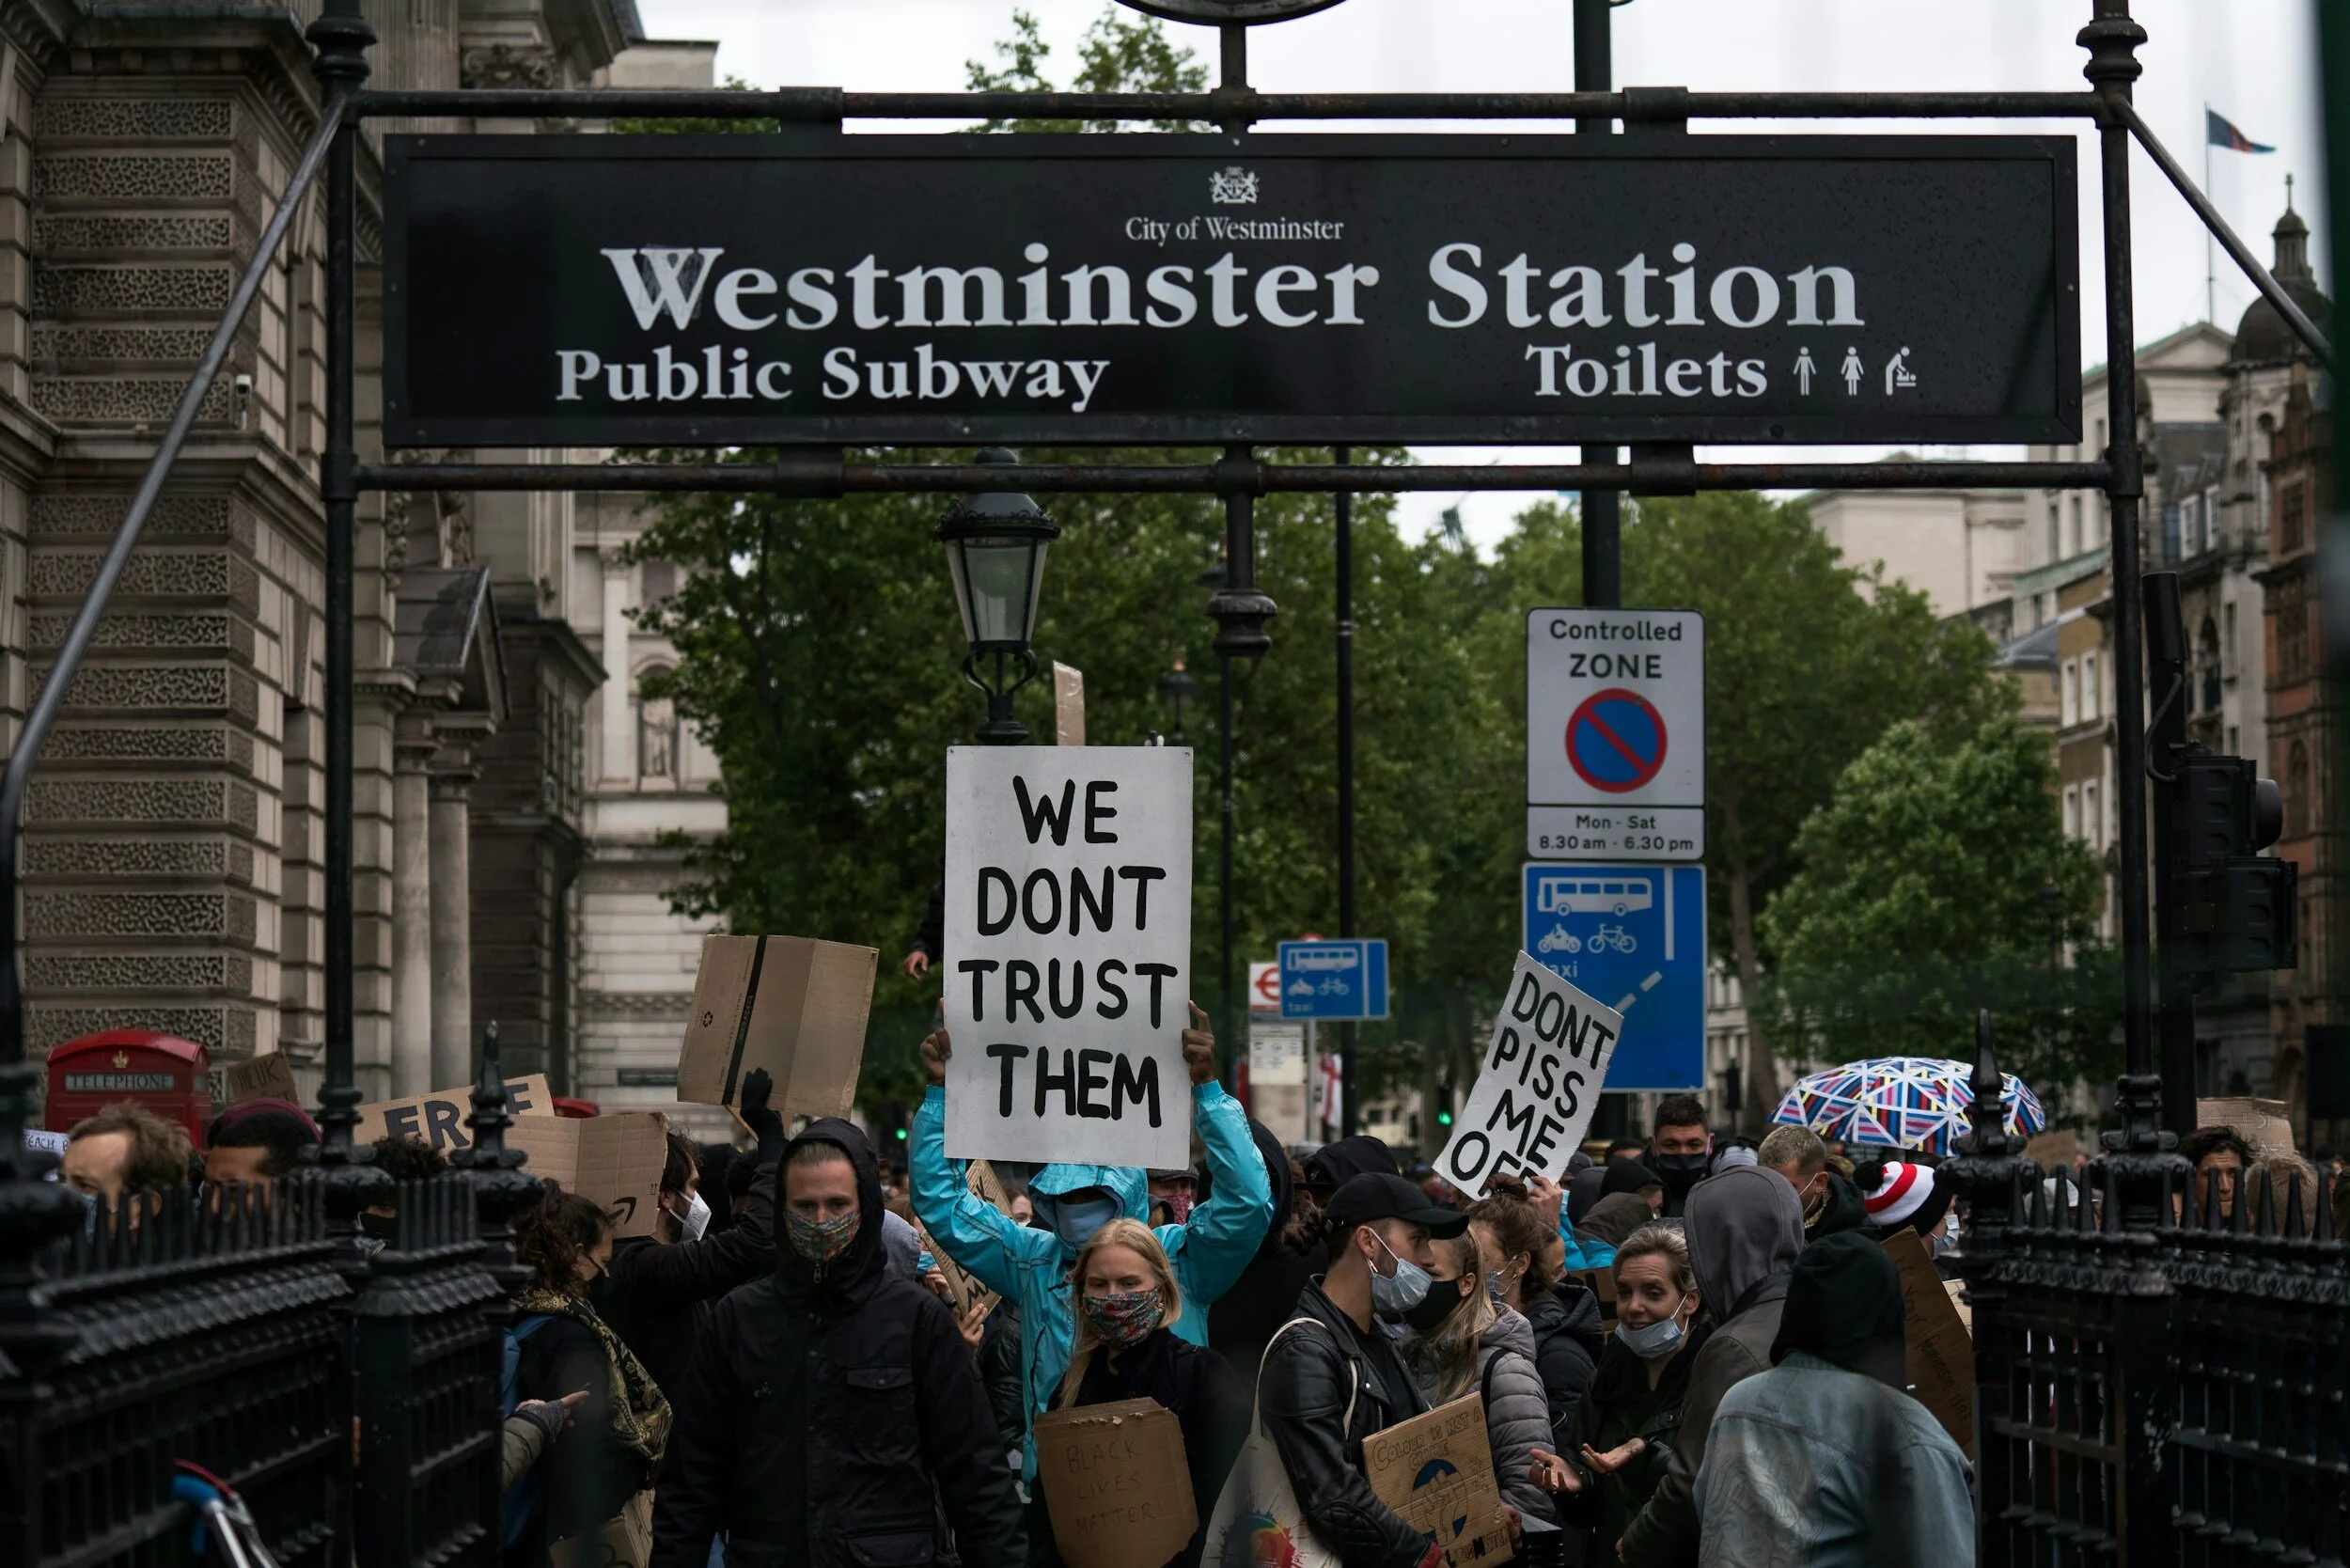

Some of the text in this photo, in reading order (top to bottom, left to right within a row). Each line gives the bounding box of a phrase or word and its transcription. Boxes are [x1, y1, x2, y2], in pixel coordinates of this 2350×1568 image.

[1125, 215, 1344, 246] City of Westminster
[600, 242, 1865, 331] Westminster Station
[555, 343, 1110, 413] Public Subway
[1524, 341, 1768, 398] Toilets
[1550, 619, 1683, 641] Controlled
[1569, 653, 1663, 679] ZONE
[1012, 775, 1119, 846] WE
[1575, 814, 1611, 829] Mon
[1627, 814, 1656, 829] Sat
[1539, 835, 1579, 850] 8.30
[1583, 839, 1606, 850] am
[1623, 837, 1665, 851] 6.30
[1668, 839, 1694, 853] pm
[977, 865, 1167, 936] DONT
[958, 957, 1179, 1029] TRUST
[1512, 971, 1615, 1070] DONT
[71, 1074, 173, 1089] TELEPHONE
[254, 1058, 281, 1088] UK
[986, 1043, 1162, 1128] THEM
[1492, 1027, 1585, 1119] PISS
[383, 1082, 534, 1150] FRE
[1486, 1089, 1565, 1170] ME
[28, 1136, 55, 1151] EACH
[1446, 1412, 1472, 1434] NOT
[1473, 1405, 1483, 1423] A
[1066, 1438, 1142, 1473] BLACK
[1409, 1438, 1450, 1471] CRIME
[1076, 1470, 1143, 1500] LIVES
